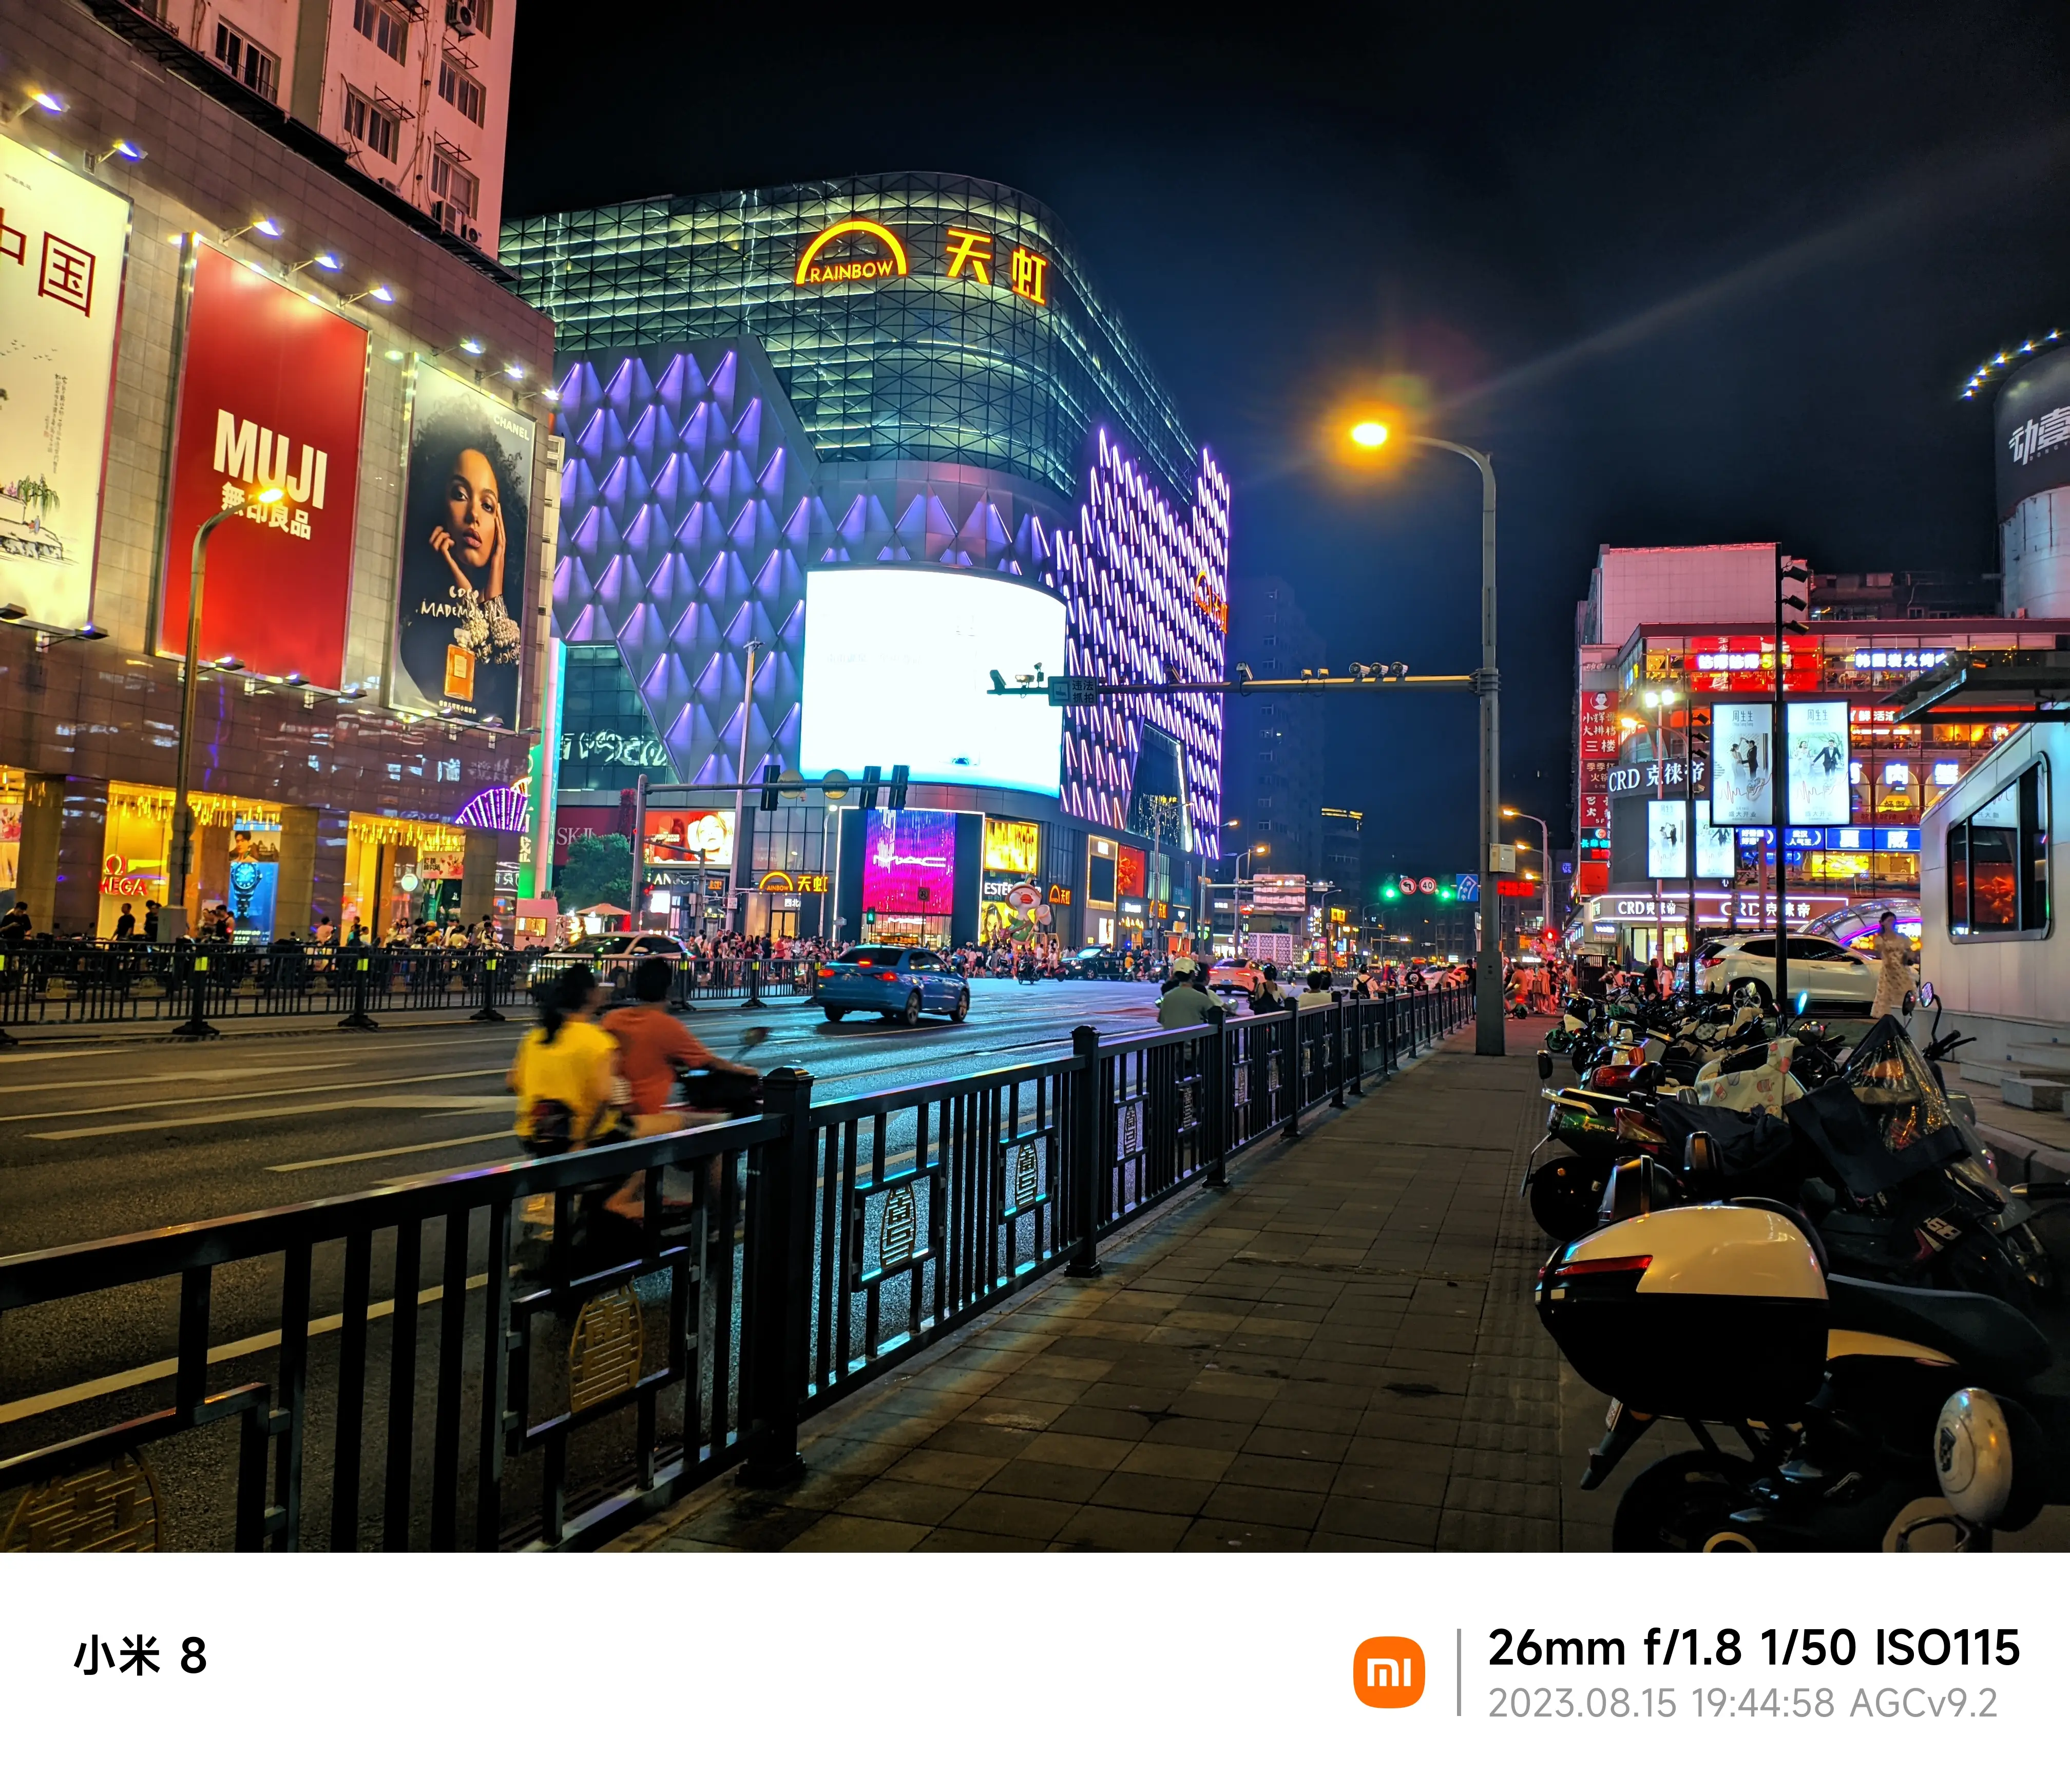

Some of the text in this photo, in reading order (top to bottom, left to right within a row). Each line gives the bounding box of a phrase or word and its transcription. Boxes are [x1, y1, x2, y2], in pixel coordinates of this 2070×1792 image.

[811, 260, 893, 283] RAINBOW
[946, 229, 1047, 306] 天虹
[493, 414, 530, 441] CHANEL
[214, 409, 328, 509] MUJI
[1072, 680, 1094, 691] 违法
[1072, 693, 1095, 703] 抓拍
[1583, 712, 1616, 724] 小辉哥
[1733, 711, 1753, 722] 周生生
[1808, 710, 1828, 720] 周生生
[1583, 725, 1616, 736] 大排档
[1585, 740, 1616, 753] 三楼
[1609, 769, 1640, 792] CRD
[873, 854, 947, 868] MAC
[99, 876, 149, 896] MEGA
[798, 875, 828, 892] 天虹
[784, 899, 801, 907] 西北
[1618, 901, 1645, 915] CRD
